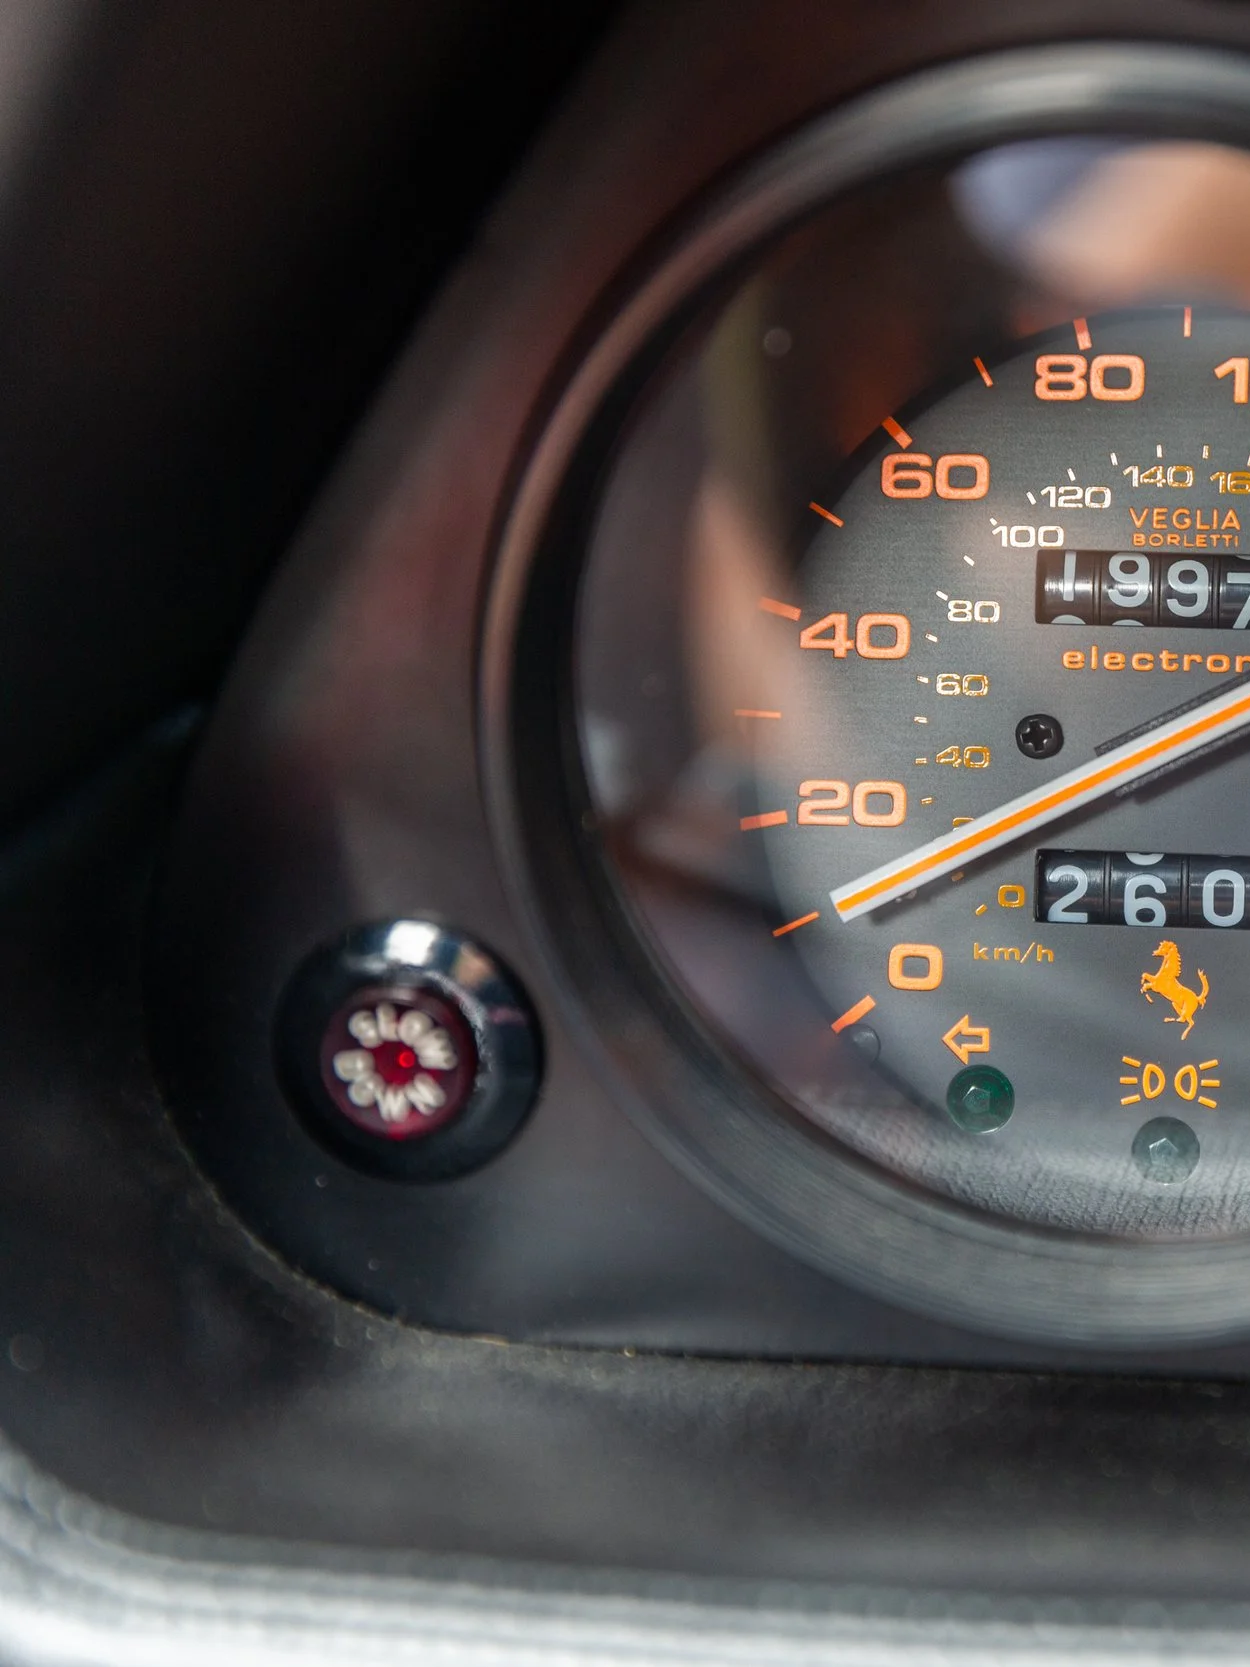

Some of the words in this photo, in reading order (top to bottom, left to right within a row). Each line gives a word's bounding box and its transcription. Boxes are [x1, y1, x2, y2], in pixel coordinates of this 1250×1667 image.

[1034, 354, 1146, 402] 80
[880, 452, 991, 501] 60
[1122, 463, 1195, 488] 140
[1040, 485, 1112, 509] 120
[1128, 506, 1241, 531] VEGLIA
[991, 525, 1065, 548] 100
[1131, 532, 1240, 549] BORLETTI
[946, 600, 1001, 624] 80
[799, 611, 912, 660] 40
[935, 673, 990, 697] 60
[935, 745, 991, 769] 40
[797, 778, 908, 828] 20
[997, 884, 1027, 909] 0
[973, 941, 1055, 963] km/h
[887, 942, 944, 992] 0
